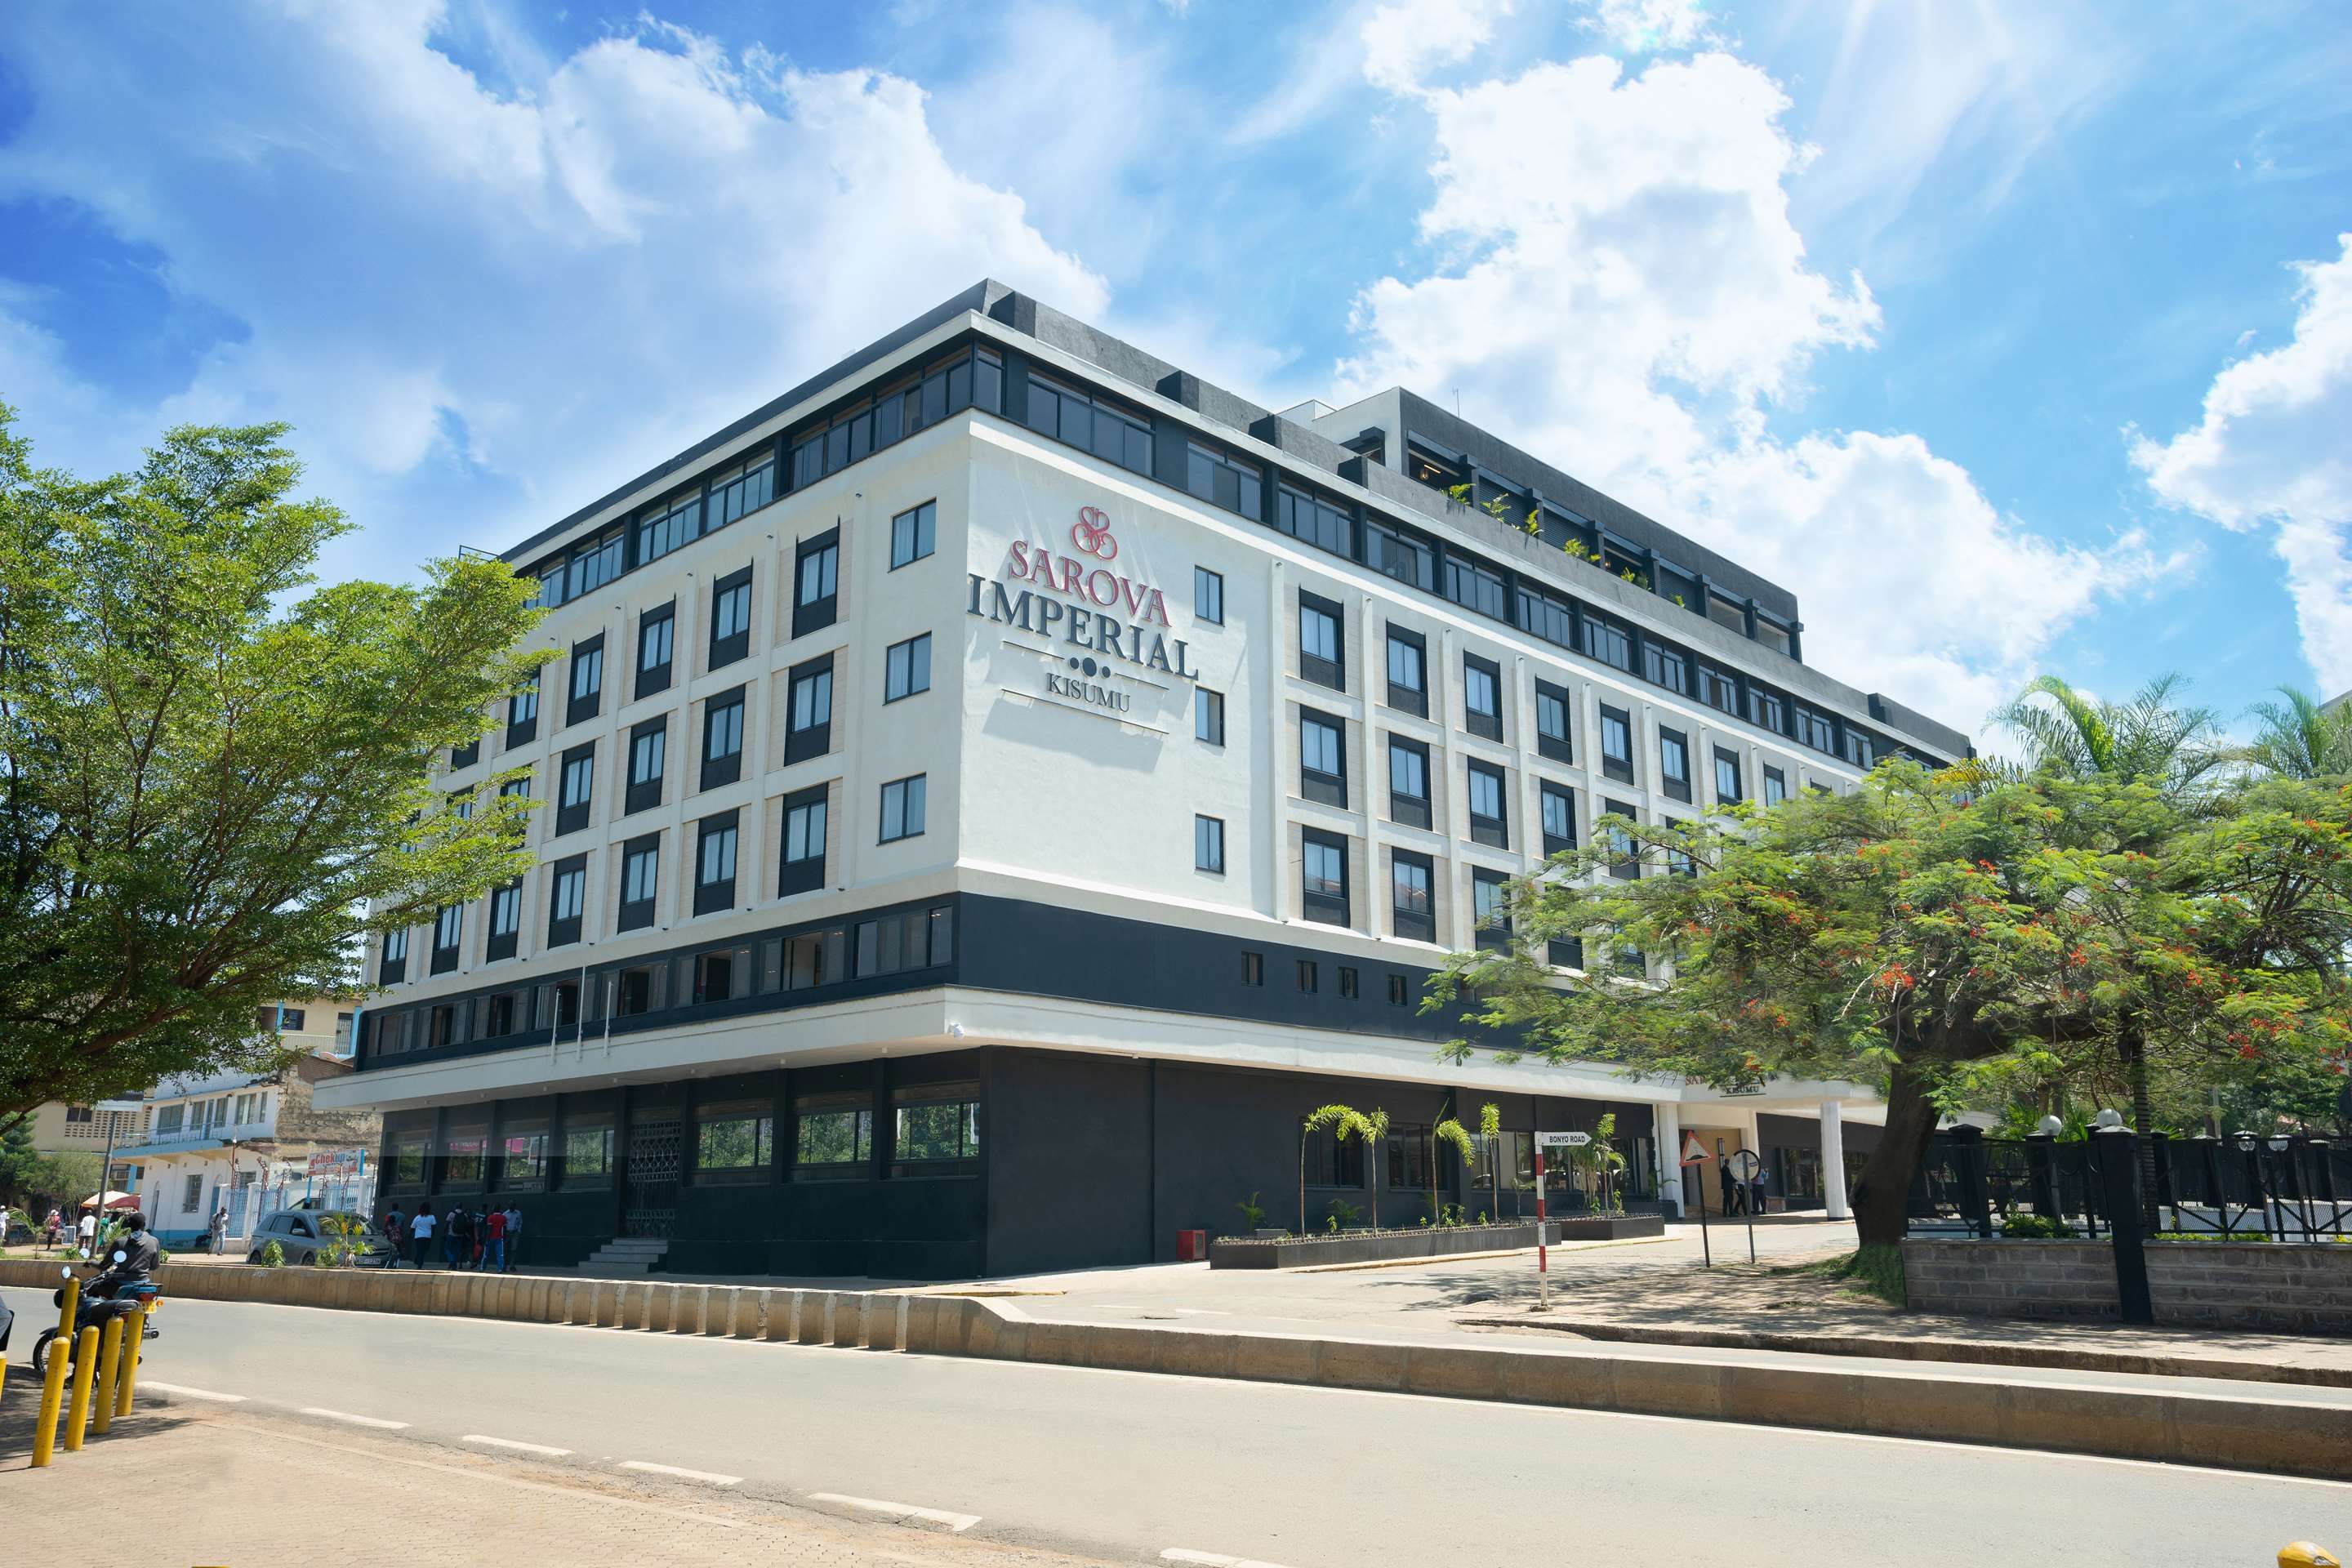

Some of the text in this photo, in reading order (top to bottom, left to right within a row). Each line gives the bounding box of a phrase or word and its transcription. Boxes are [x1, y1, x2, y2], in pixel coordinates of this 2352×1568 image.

[1008, 540, 1173, 628] SAROVA
[966, 572, 1199, 680] IMPERIAL
[1046, 672, 1131, 712] KISUMU
[1726, 1086, 1759, 1094] KISUMU
